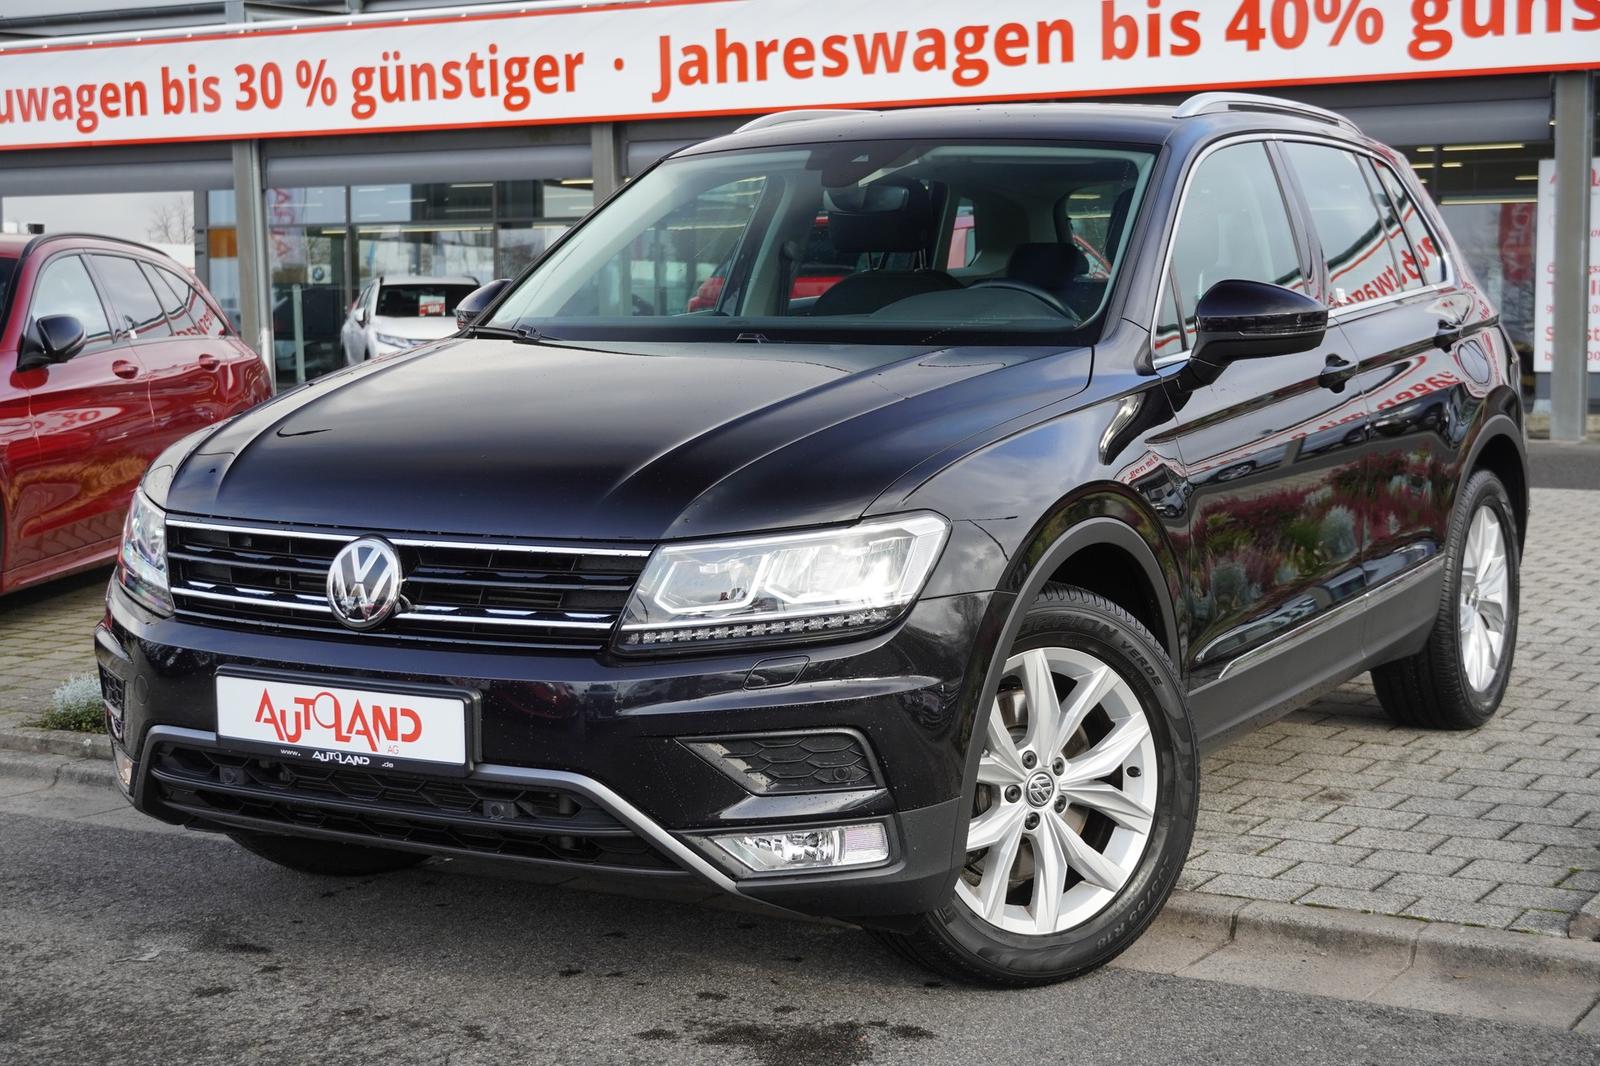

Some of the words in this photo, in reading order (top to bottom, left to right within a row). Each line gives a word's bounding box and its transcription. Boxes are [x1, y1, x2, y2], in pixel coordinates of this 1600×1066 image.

[161, 64, 221, 115] bis
[234, 61, 283, 111] 30
[296, 59, 338, 107] %
[351, 44, 584, 120] günstiger
[651, 18, 1074, 103] Jahreswagen
[1102, 0, 1201, 60] bis
[1224, 0, 1384, 52] 40%
[1119, 639, 1164, 687] VERDE
[280, 748, 301, 757] www.
[381, 760, 394, 768] .de
[387, 744, 400, 755] AG
